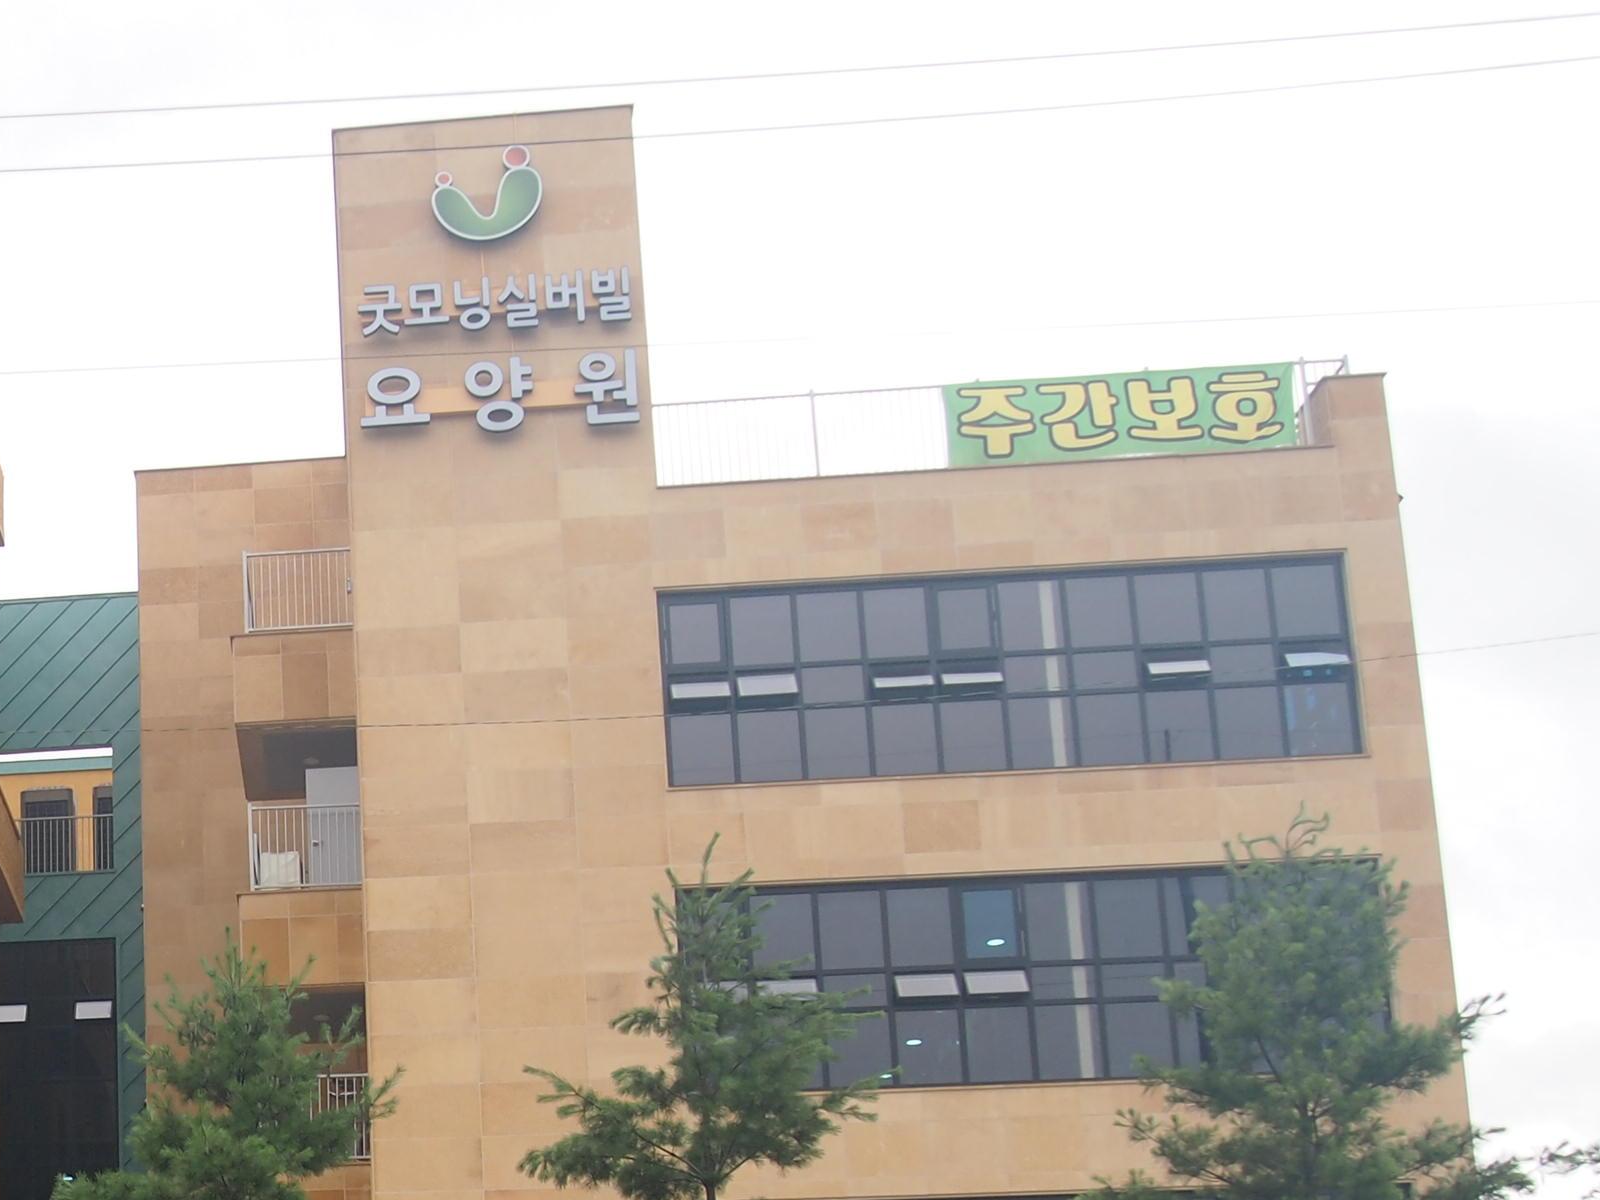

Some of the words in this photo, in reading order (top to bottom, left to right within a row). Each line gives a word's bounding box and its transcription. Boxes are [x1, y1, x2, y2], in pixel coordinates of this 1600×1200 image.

[357, 265, 632, 337] 굿모닝실버빌
[360, 347, 641, 433] 요양원
[956, 370, 1285, 459] 주간보호
